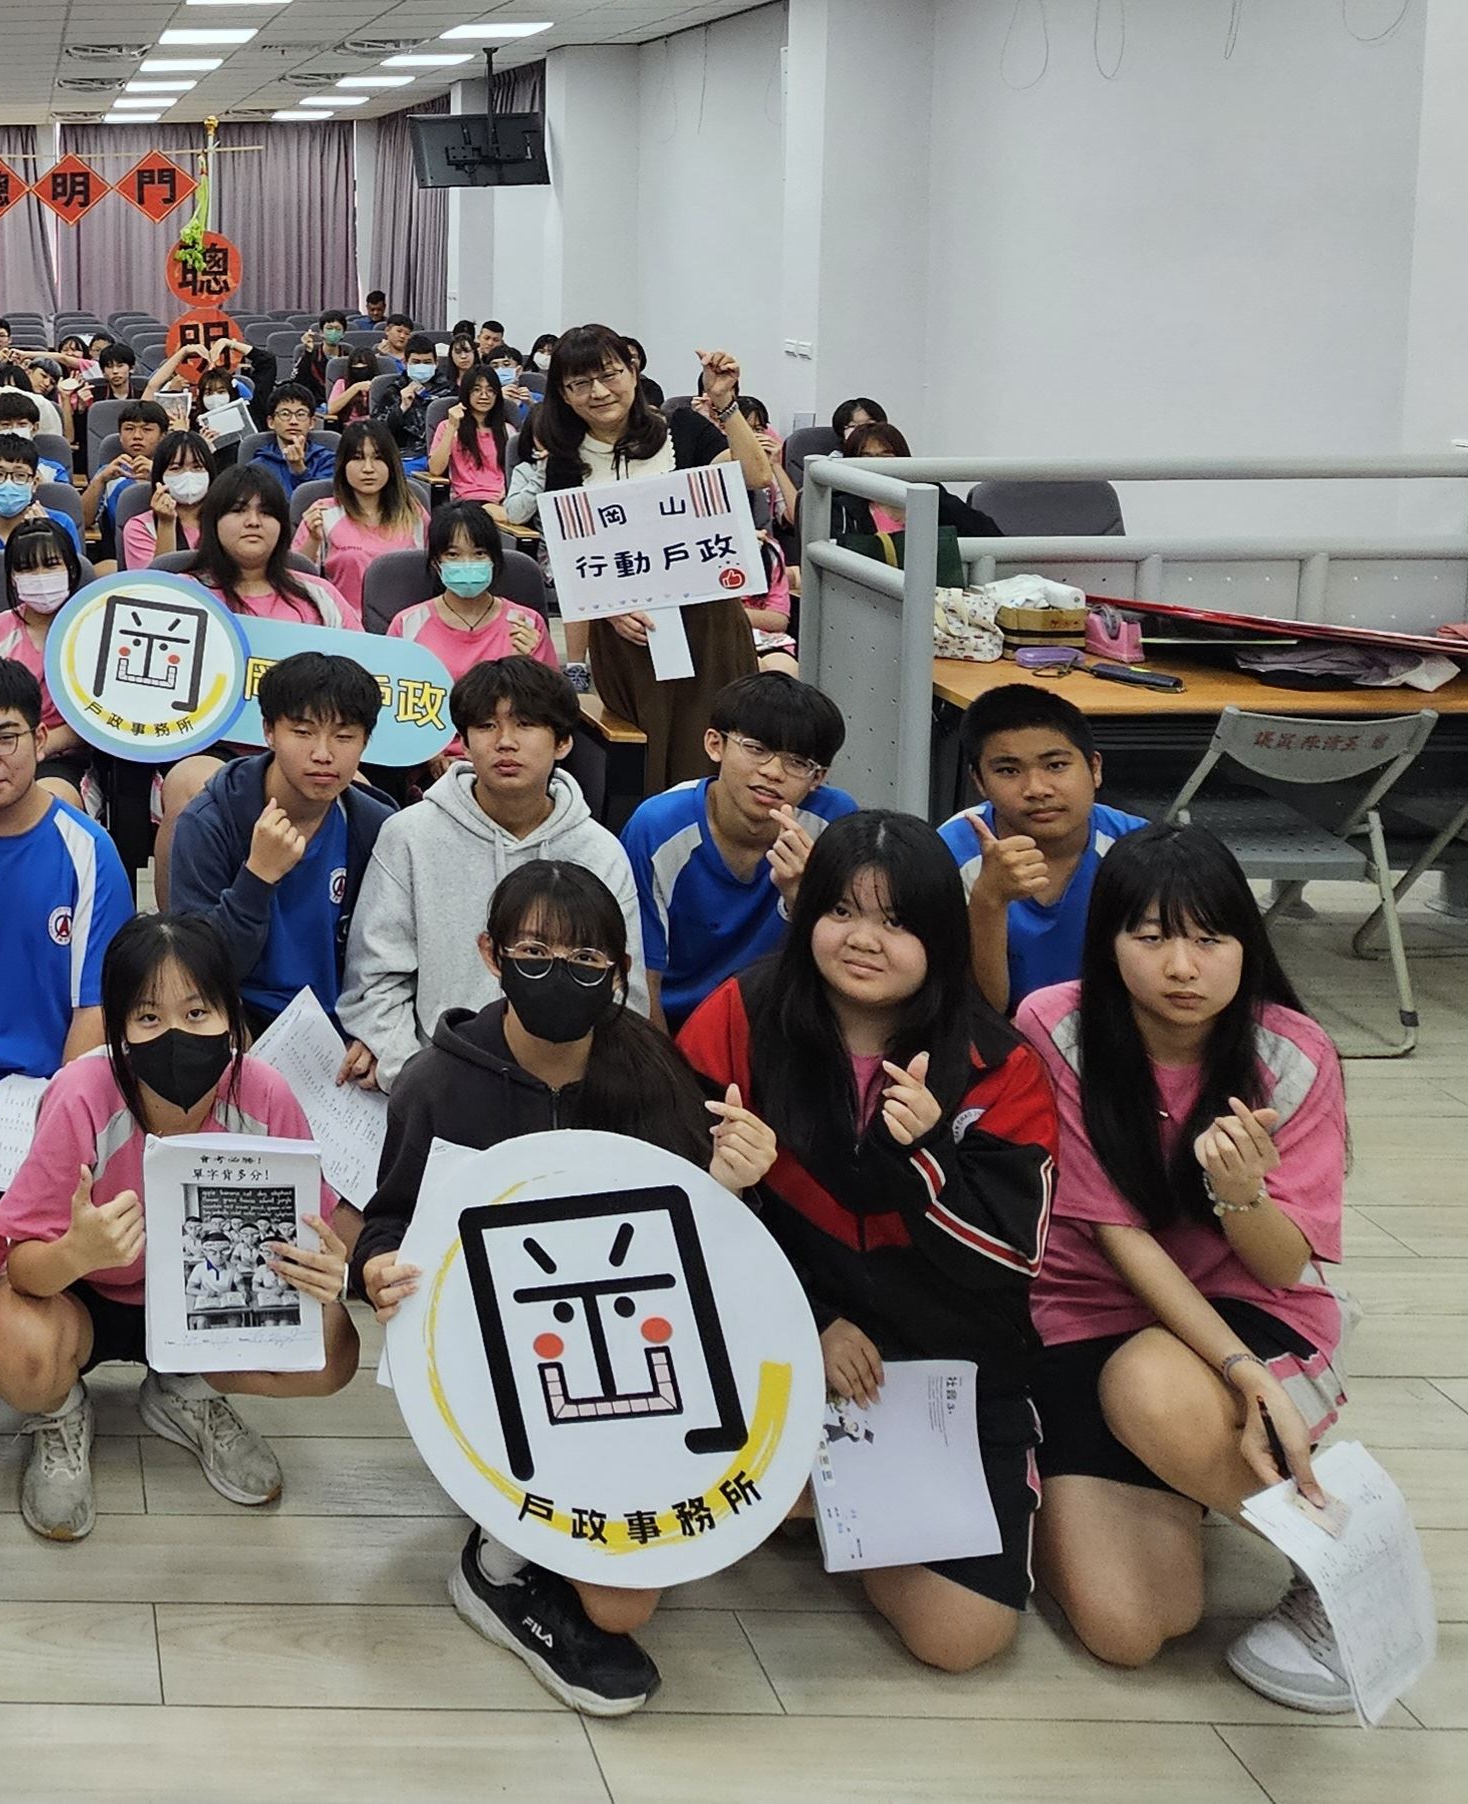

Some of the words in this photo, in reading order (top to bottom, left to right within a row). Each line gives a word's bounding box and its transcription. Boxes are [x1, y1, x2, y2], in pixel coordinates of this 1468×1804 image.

[597, 496, 686, 528] 岡山
[575, 533, 737, 578] 行動戶政
[83, 700, 195, 738] 戶政事務所
[518, 1471, 762, 1544] 戶政事務所
[521, 1616, 554, 1648] FILA
